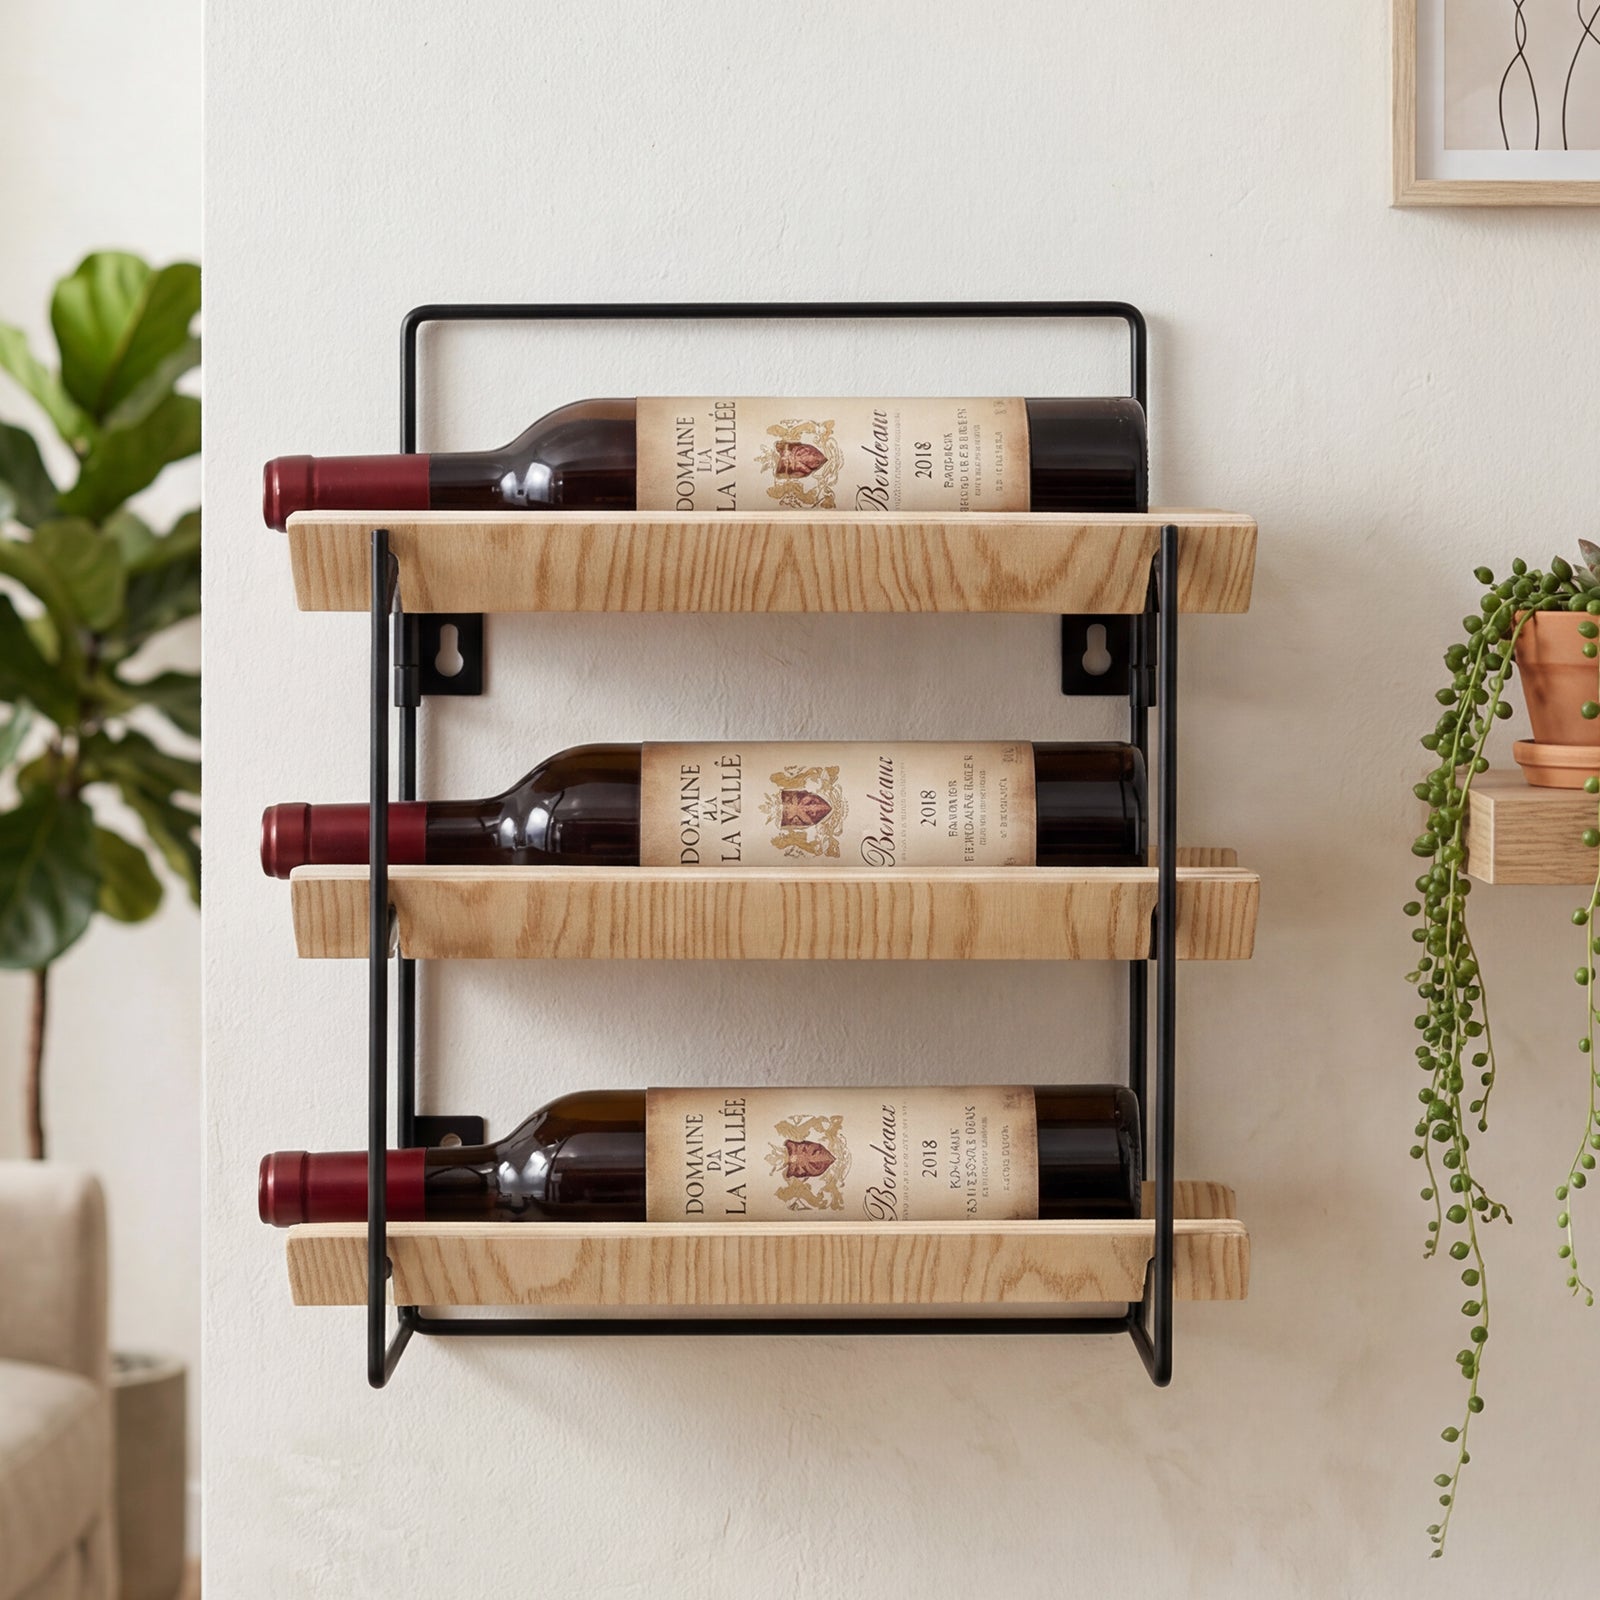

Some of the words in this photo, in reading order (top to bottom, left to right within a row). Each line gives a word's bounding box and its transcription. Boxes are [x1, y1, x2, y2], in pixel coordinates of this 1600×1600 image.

[708, 401, 736, 475] VALLÉE
[914, 441, 932, 479] 2018
[920, 790, 937, 827] 2018
[721, 831, 741, 862] LA
[718, 1098, 746, 1176] VALLÉE
[685, 1113, 704, 1215] DOMAINE
[863, 1104, 898, 1221] Bordeaux
[921, 1139, 938, 1178] 2018
[725, 1183, 747, 1215] LA
